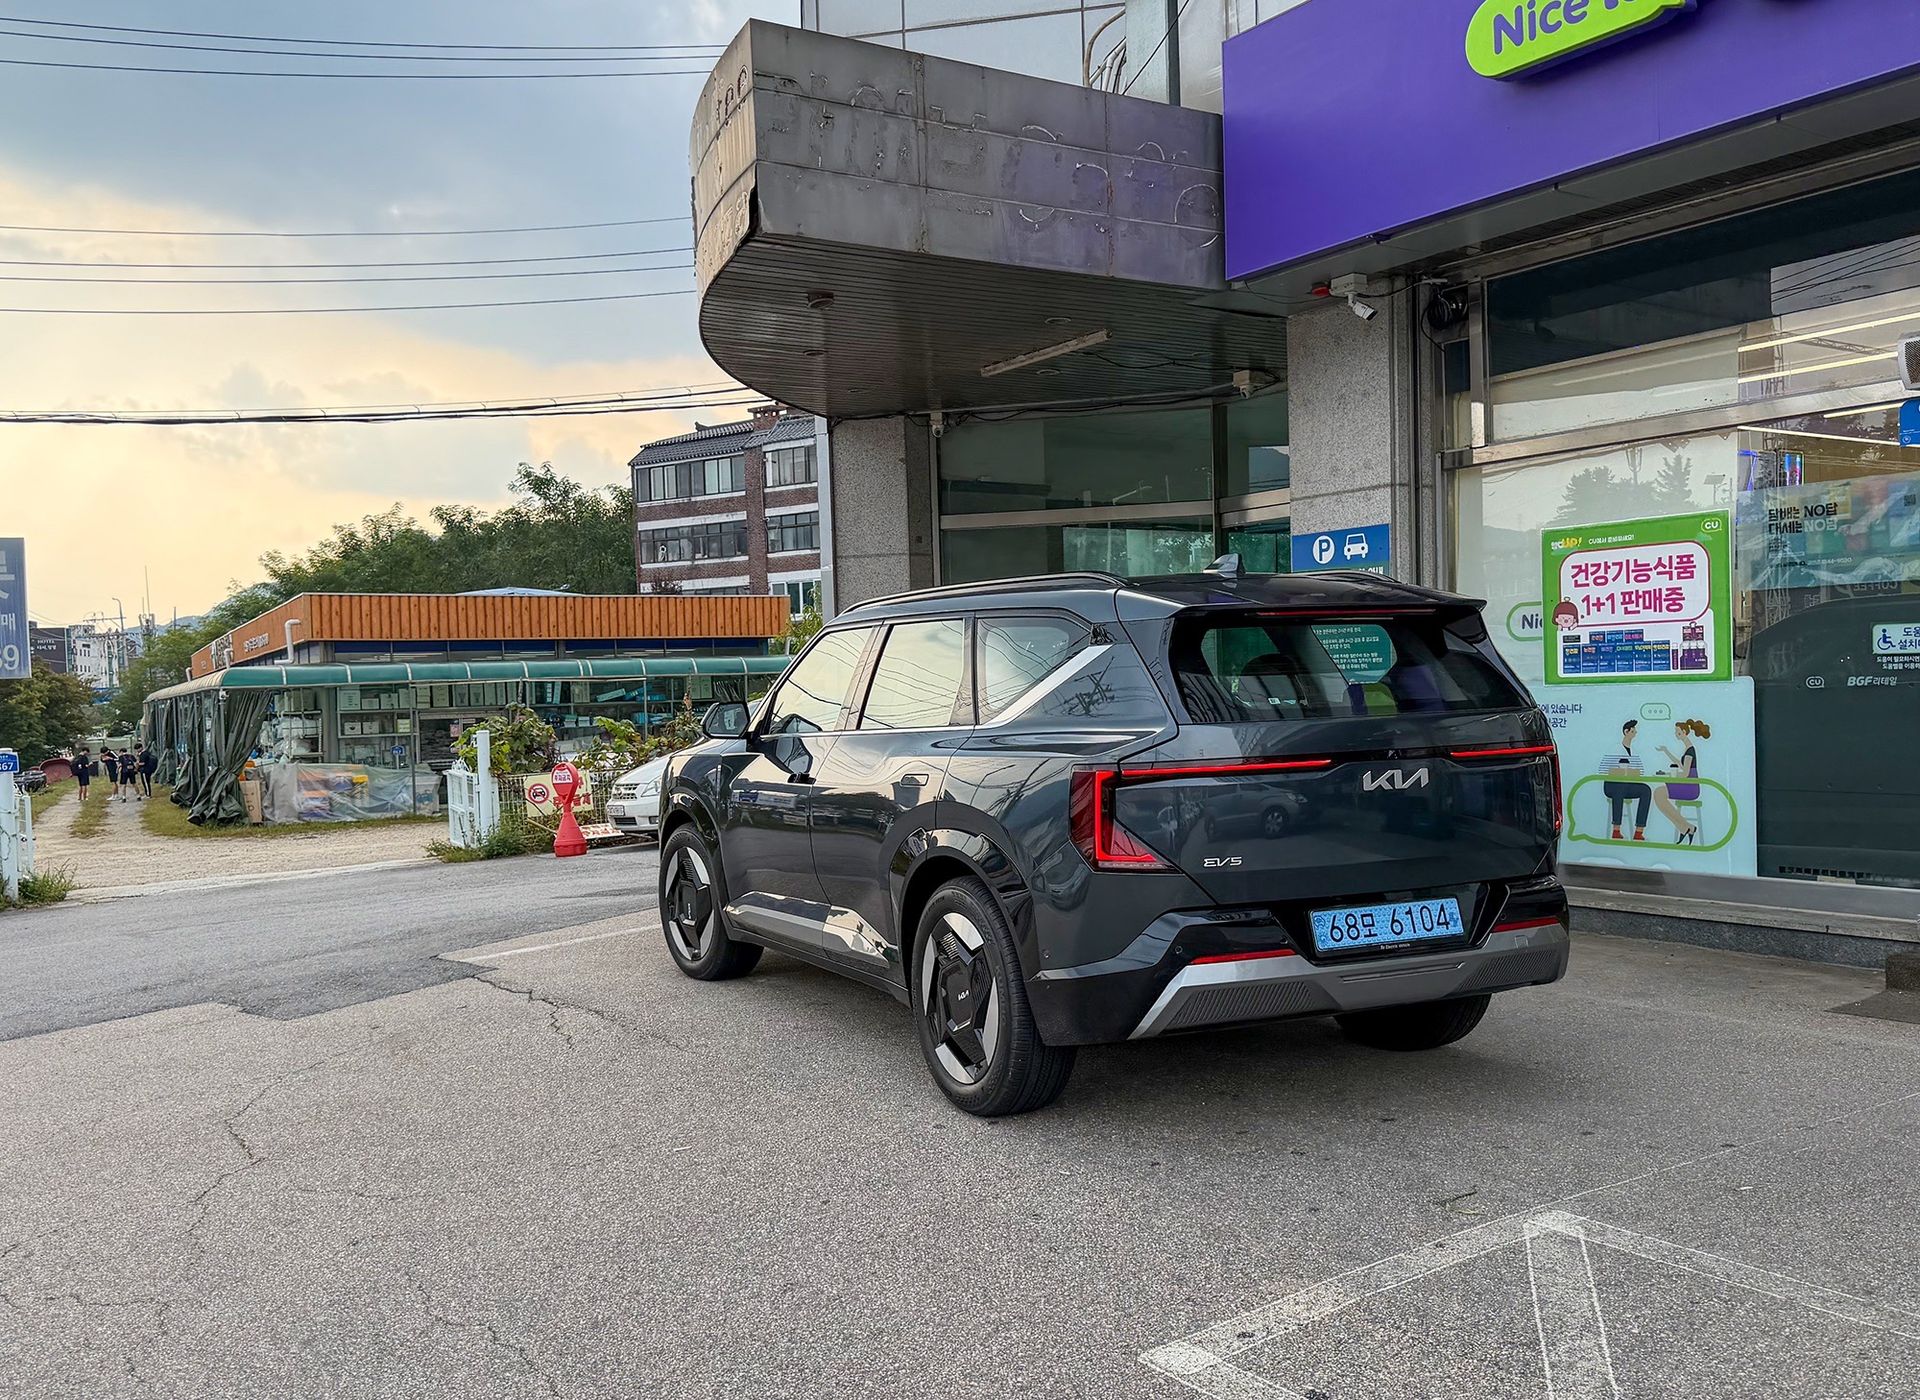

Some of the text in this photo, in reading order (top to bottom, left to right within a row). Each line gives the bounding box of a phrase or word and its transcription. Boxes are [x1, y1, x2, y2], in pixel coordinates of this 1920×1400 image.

[1493, 0, 1589, 55] Nice
[1705, 521, 1719, 530] CU
[1571, 553, 1697, 588] 건강기능식품
[1581, 586, 1686, 616] 1+1 판매중
[1521, 612, 1543, 630] Ni
[1898, 639, 1920, 650] 설치
[1808, 678, 1821, 686] CU
[1847, 676, 1898, 687] BGF리테일
[1551, 703, 1583, 714] 있습니다
[1363, 767, 1429, 791] KIA
[1203, 856, 1243, 868] EV5
[1329, 903, 1450, 942] 68모 6104
